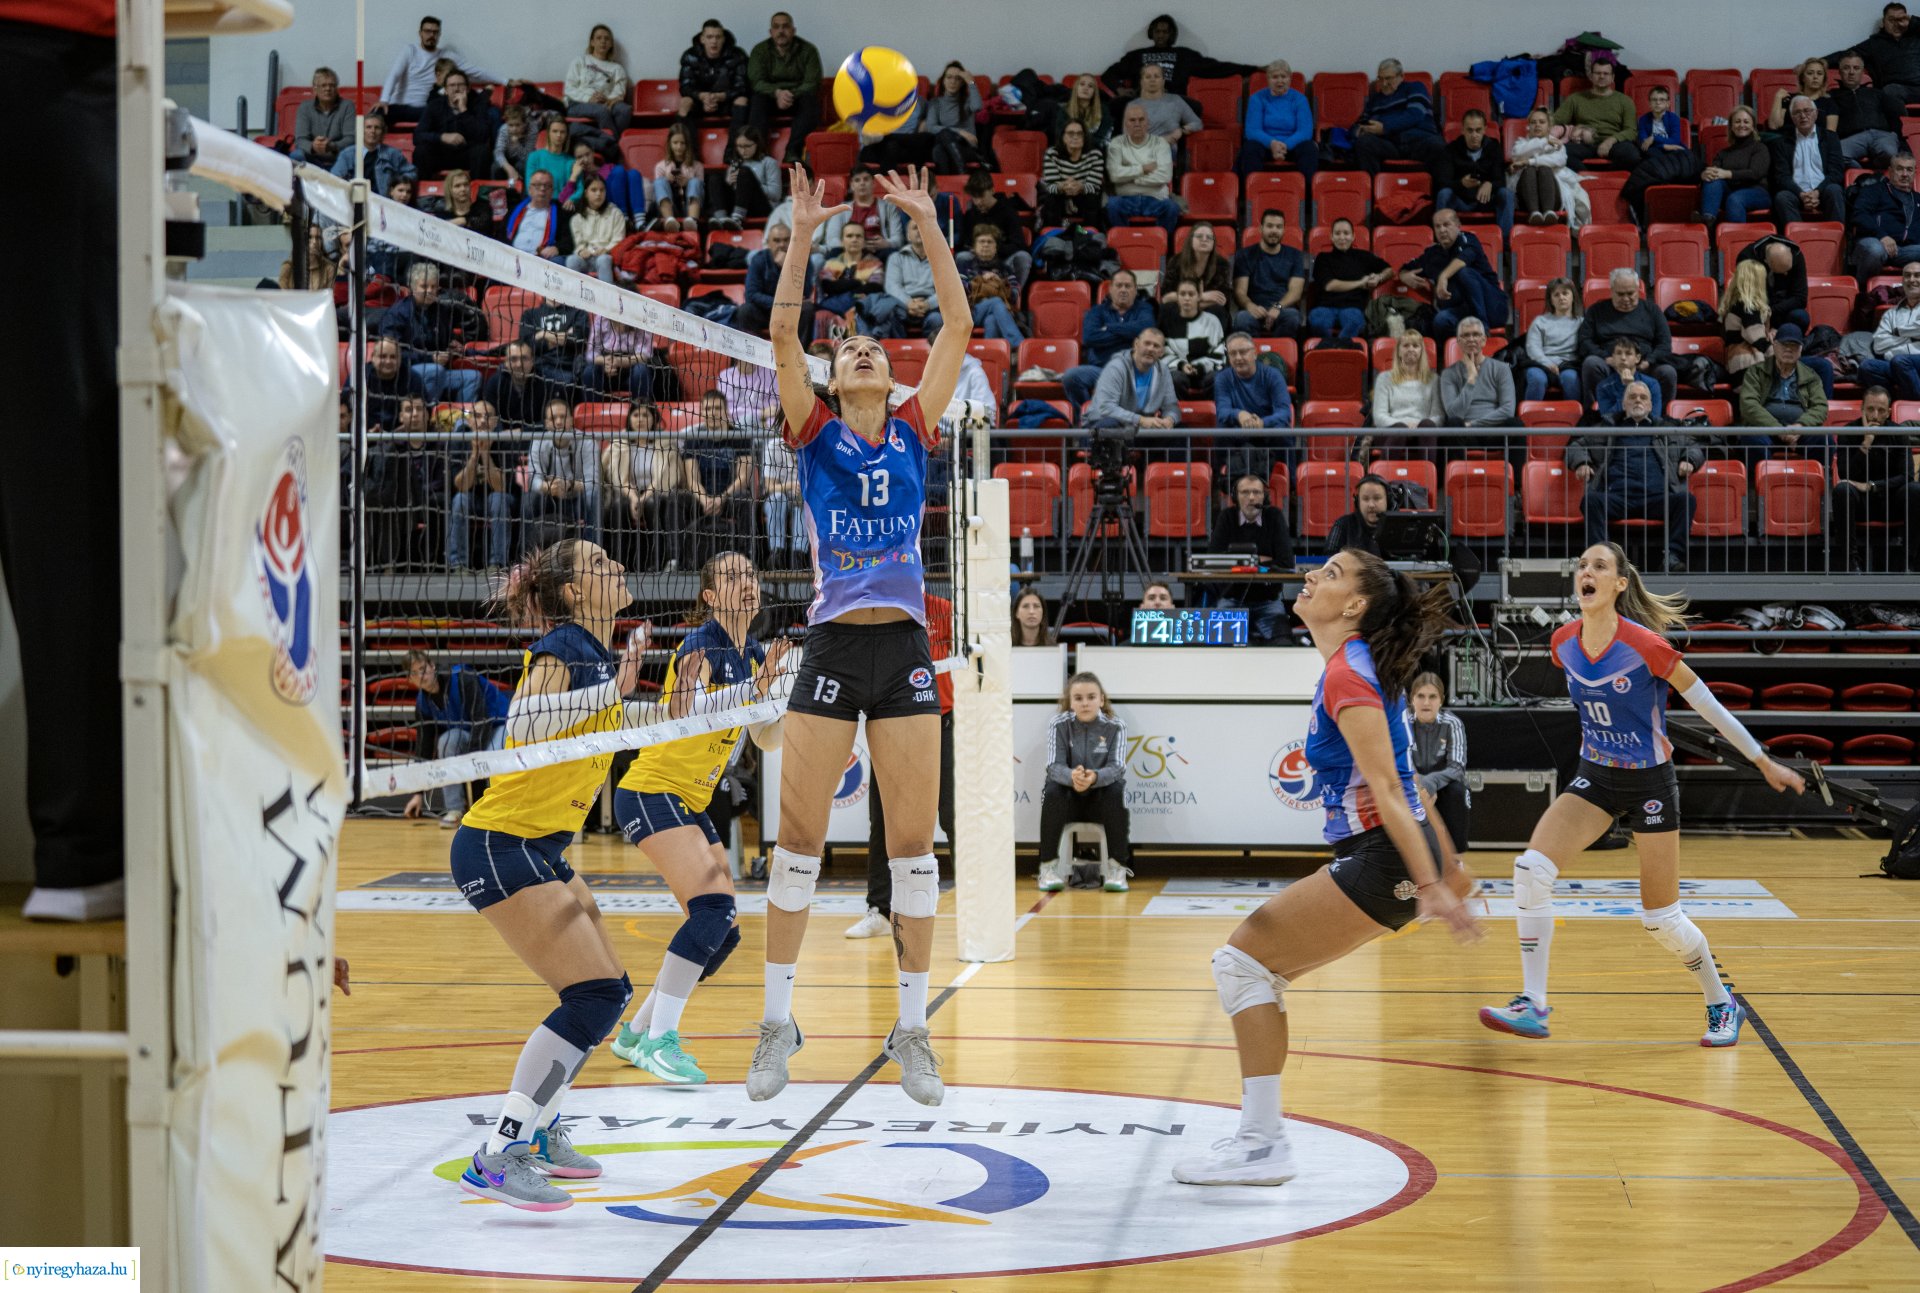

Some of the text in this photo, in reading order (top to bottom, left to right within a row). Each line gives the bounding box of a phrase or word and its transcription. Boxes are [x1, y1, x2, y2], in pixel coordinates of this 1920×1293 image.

[857, 468, 890, 506] 13
[828, 508, 915, 536] FATUM
[1135, 611, 1165, 620] KNRC
[1211, 611, 1248, 620] FATUM
[1137, 620, 1170, 643] 14
[1212, 620, 1241, 643] 11
[813, 675, 841, 704] 13
[1584, 701, 1613, 727] 10
[1137, 781, 1168, 789] MAGYAR
[1570, 776, 1592, 789] 10
[1126, 789, 1199, 805] PLABDA
